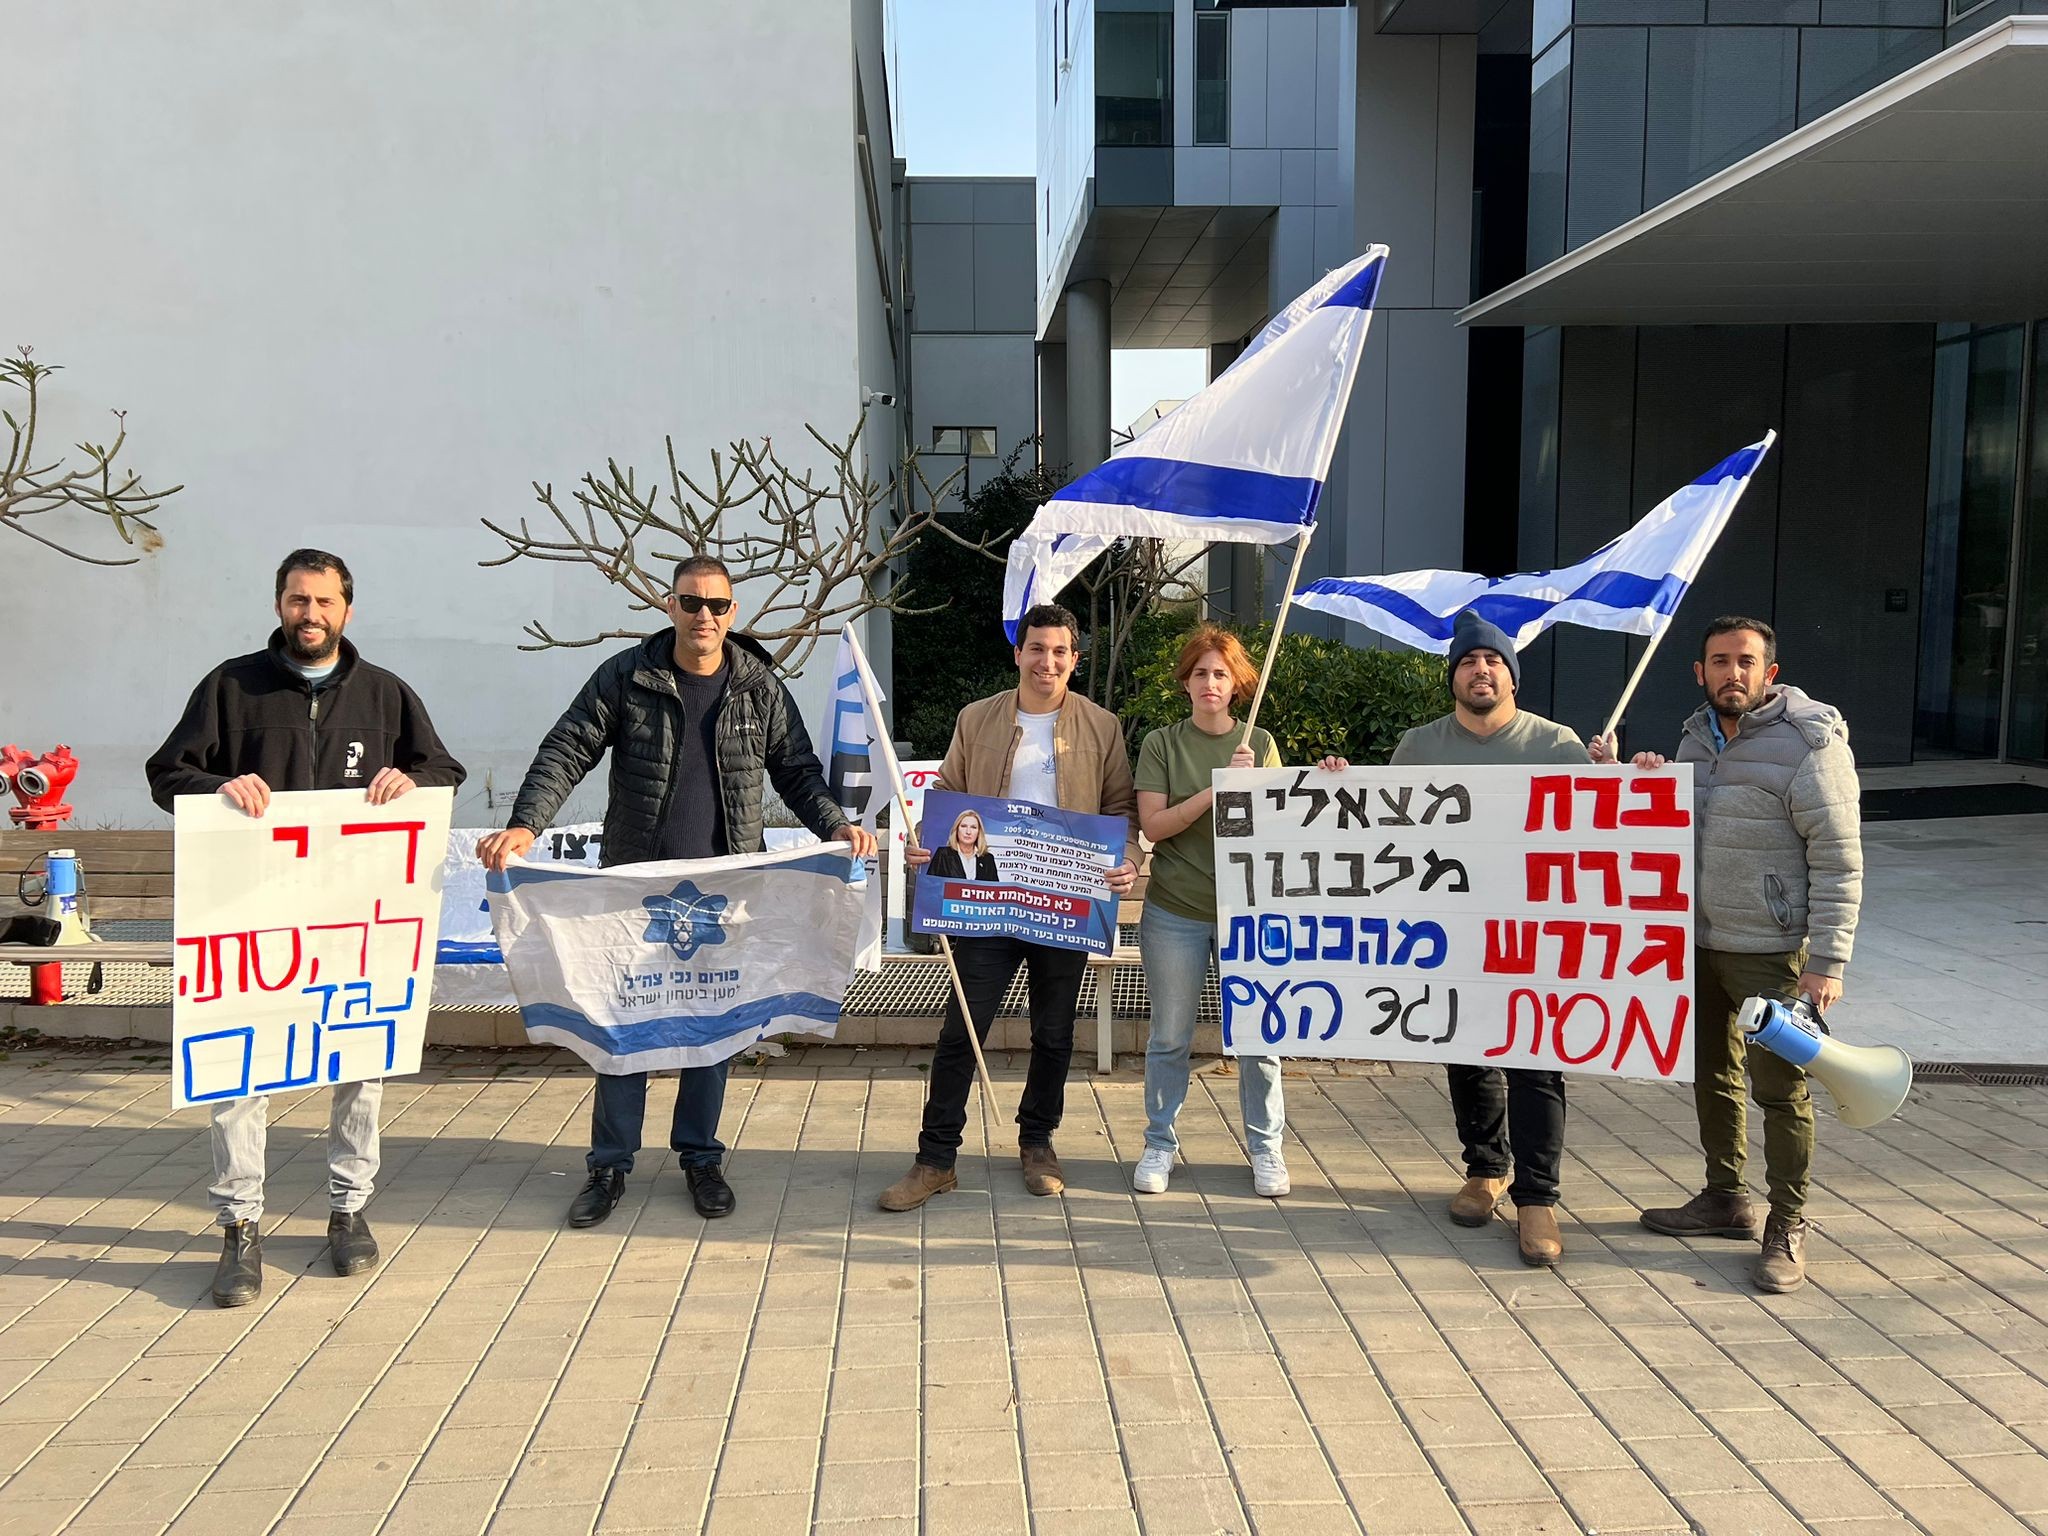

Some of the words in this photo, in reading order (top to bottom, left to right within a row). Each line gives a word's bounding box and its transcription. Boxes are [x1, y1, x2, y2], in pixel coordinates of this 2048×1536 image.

[1215, 770, 1472, 838] מצאלים
[1523, 774, 1691, 832] ברח
[1014, 839, 1044, 849] דומיננטי
[1046, 844, 1059, 855] קול
[272, 821, 426, 884] די
[1034, 854, 1048, 863] עוד
[1061, 848, 1075, 856] הוא
[999, 861, 1028, 871] לרצונות
[1049, 856, 1074, 868] לעצמו
[1029, 866, 1044, 874] גומי
[1046, 869, 1072, 880] חותמת
[1030, 877, 1054, 888] הנשיא
[1074, 873, 1095, 883] אהיה
[1094, 878, 1105, 886] לא
[1525, 850, 1690, 912] ברח
[1056, 881, 1068, 890] של
[1070, 885, 1092, 895] המינוי
[961, 888, 995, 900] אחים
[999, 890, 1051, 907] למלחמת
[951, 902, 1006, 916] האזרחים
[1054, 899, 1072, 911] לא
[1008, 906, 1060, 926] להכרעת
[922, 917, 963, 929] המשפט
[964, 921, 1001, 931] מערכת
[1004, 922, 1030, 936] תיקון
[1063, 917, 1077, 929] כן
[1032, 929, 1054, 941] בעד
[1220, 913, 1449, 969] מהכנסת
[1056, 934, 1106, 950] סטודנטים
[176, 899, 424, 1003] להסתה
[669, 971, 692, 984] נכי
[698, 969, 739, 984] פורום
[302, 976, 415, 1024] נגד
[619, 991, 661, 1008] ישראל
[666, 988, 708, 1005] ביטחון
[1221, 975, 1343, 1047] העם
[1365, 984, 1459, 1045] נגד
[1483, 988, 1690, 1077] מסית
[182, 1018, 396, 1101] העם
